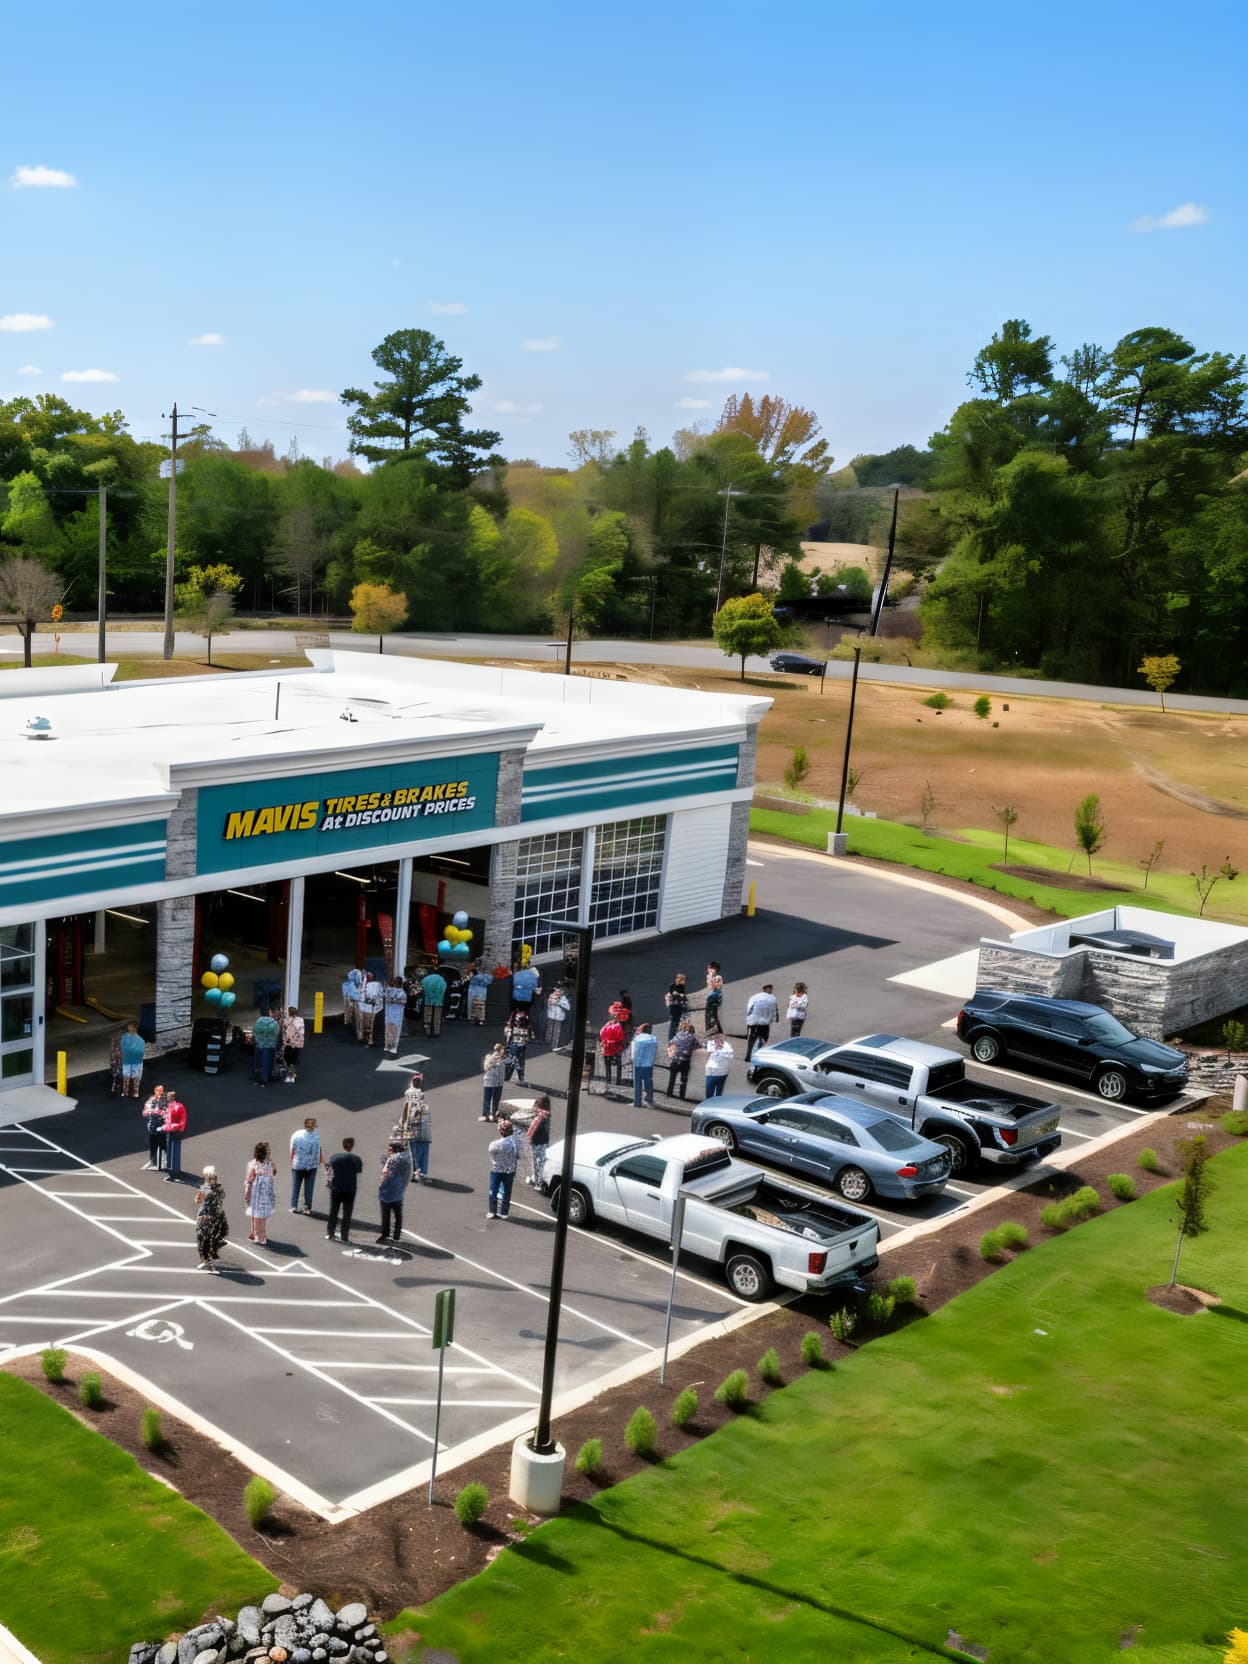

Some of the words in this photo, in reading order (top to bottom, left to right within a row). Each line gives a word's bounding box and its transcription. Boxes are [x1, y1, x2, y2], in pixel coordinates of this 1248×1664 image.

[321, 815, 343, 831] At
[345, 804, 422, 828] DISCOUNT
[424, 796, 476, 816] PRICES
[327, 793, 381, 815] TIRES
[381, 793, 392, 807] &
[393, 781, 469, 805] BRAKES
[225, 801, 320, 840] MAVIS
